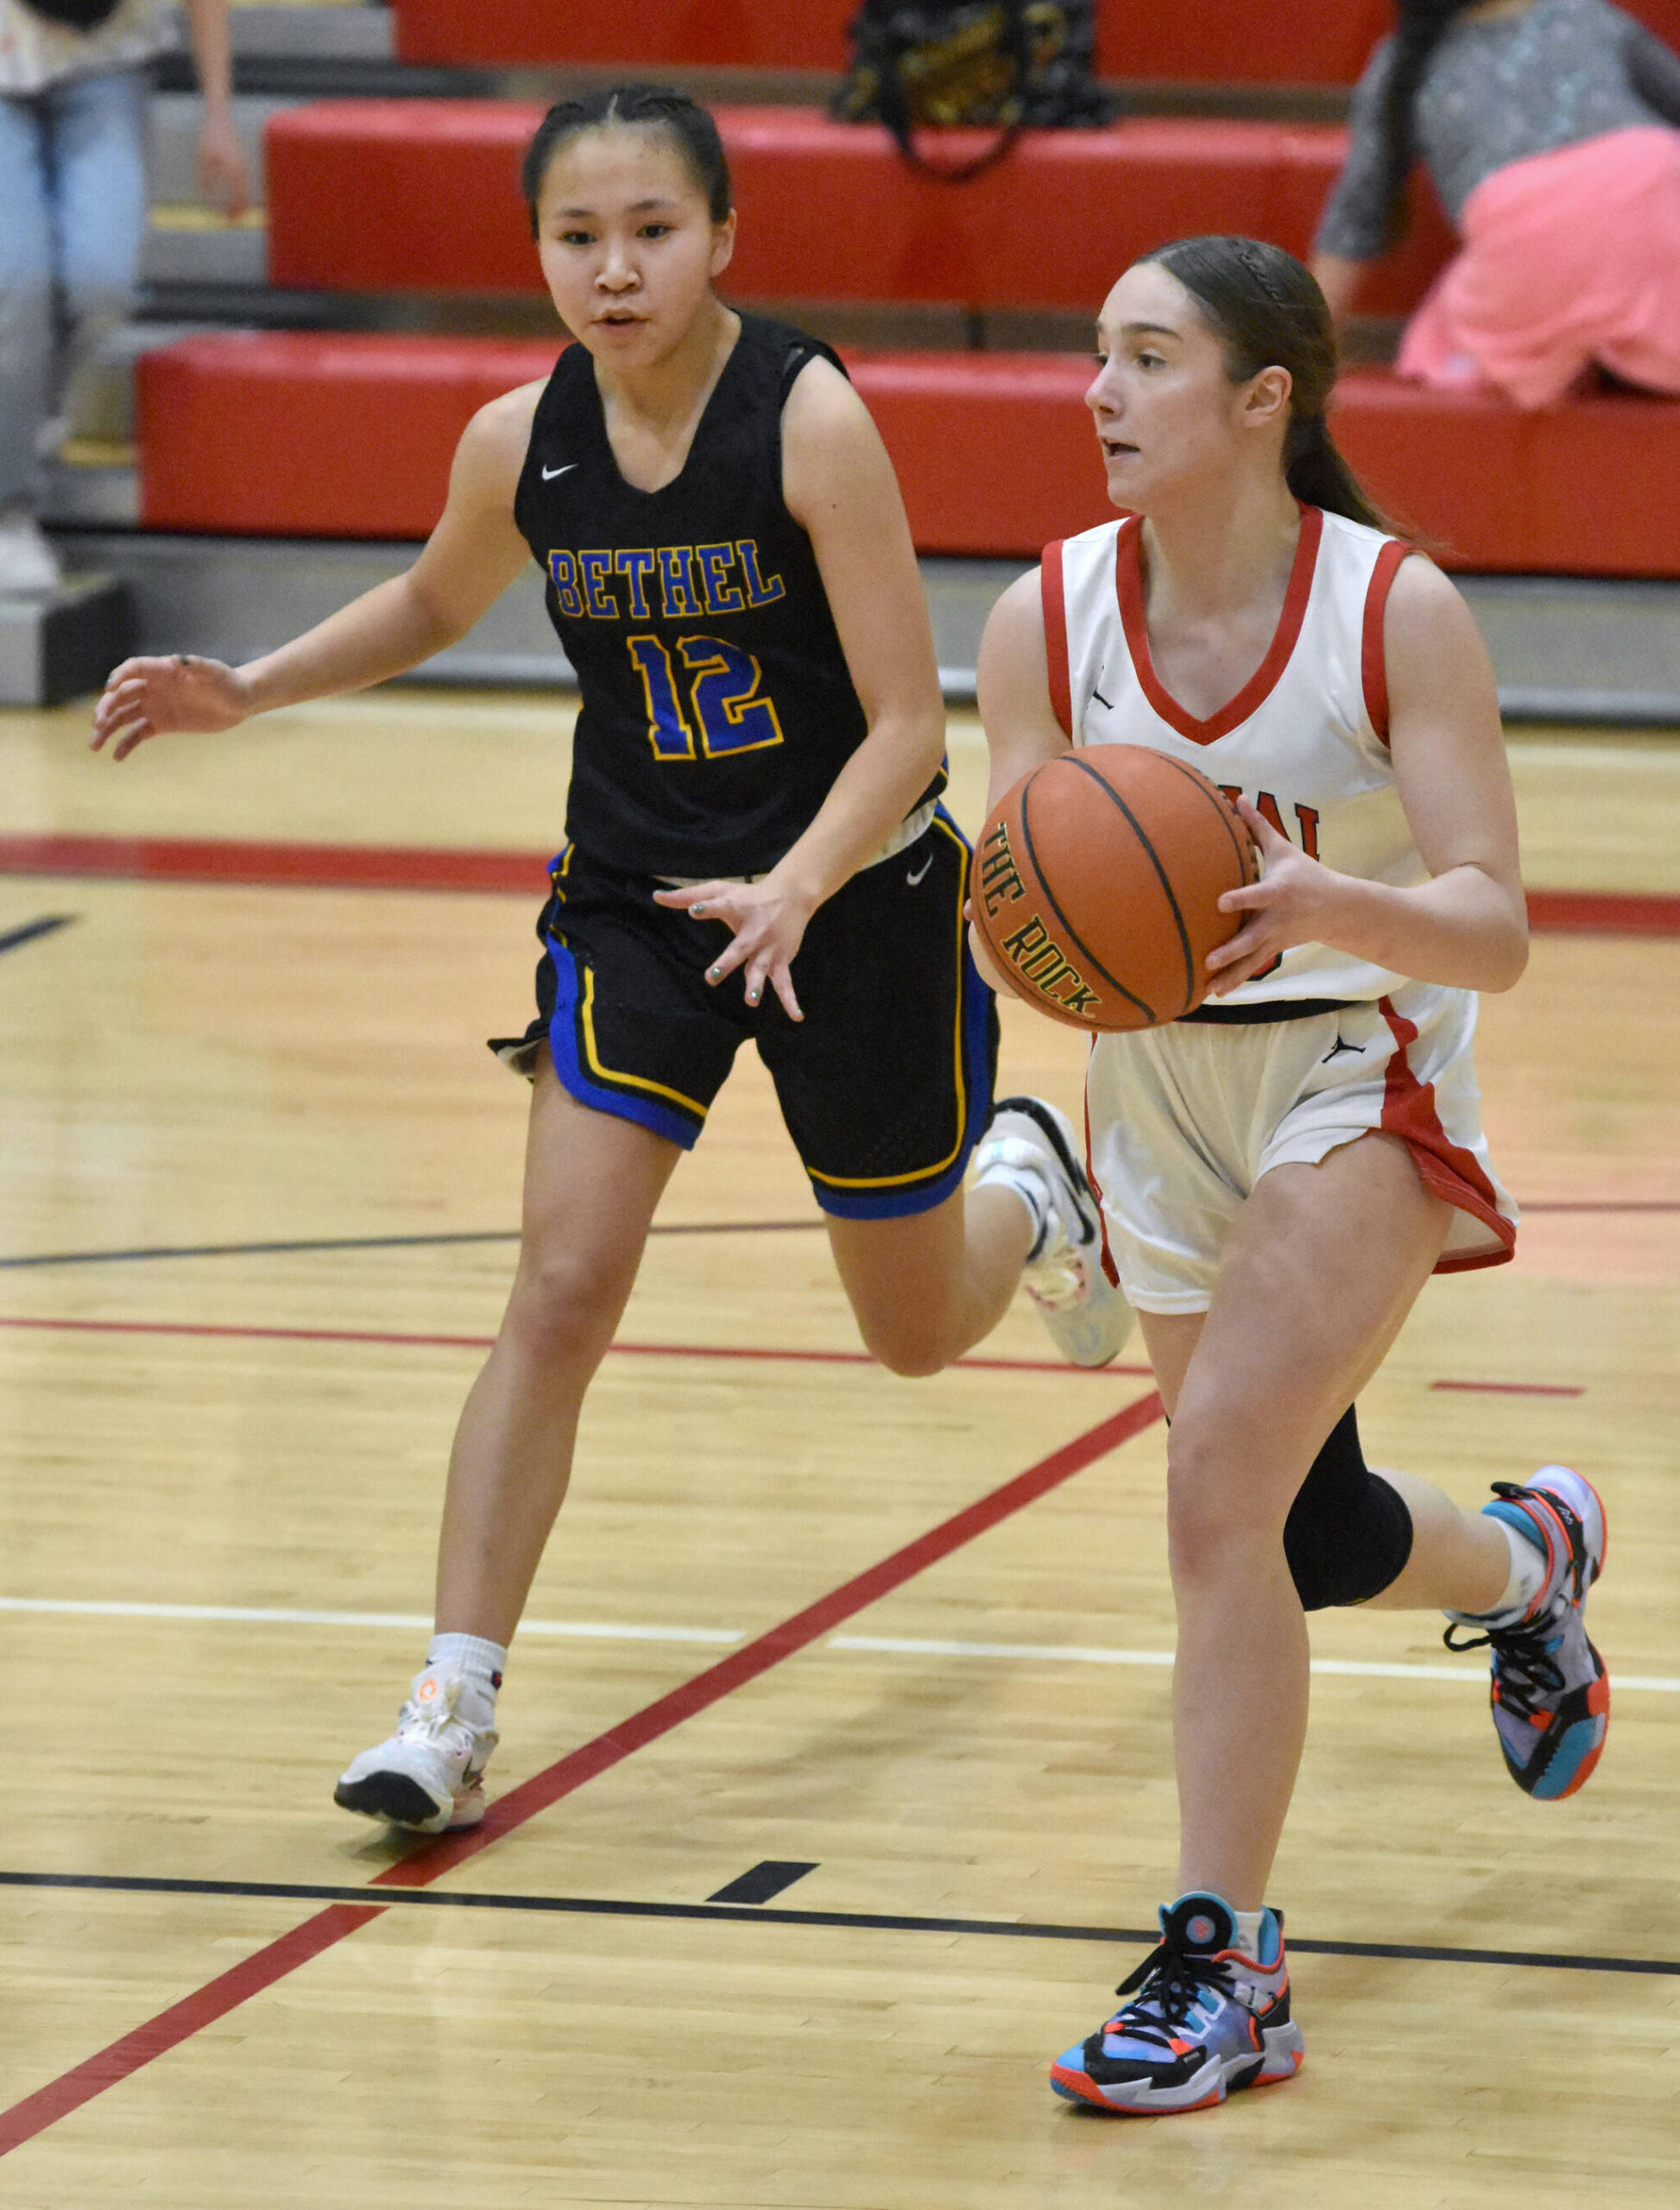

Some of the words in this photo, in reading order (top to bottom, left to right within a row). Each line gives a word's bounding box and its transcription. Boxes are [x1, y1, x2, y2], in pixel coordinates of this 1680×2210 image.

[548, 540, 786, 619] BETHEL
[627, 635, 785, 761] 12
[982, 821, 1026, 918] THE
[1001, 912, 1103, 1019] ROCK
